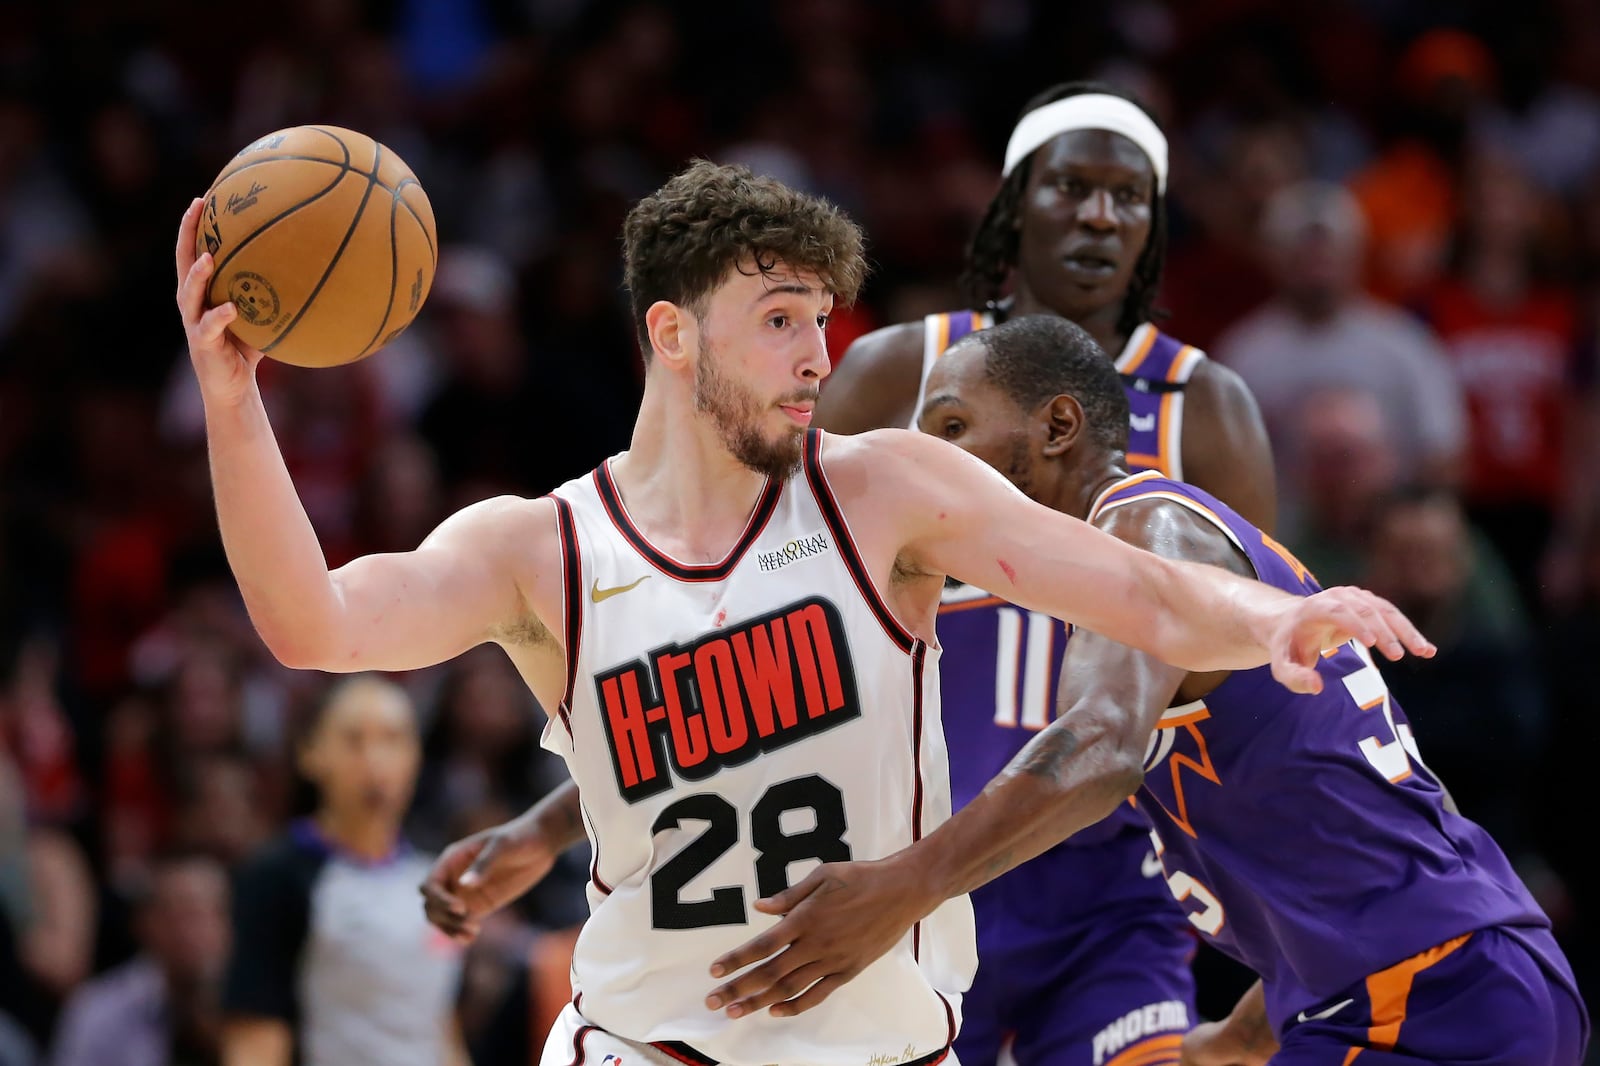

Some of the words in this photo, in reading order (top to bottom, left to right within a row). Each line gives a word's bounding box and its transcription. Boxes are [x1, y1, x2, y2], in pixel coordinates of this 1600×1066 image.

[757, 533, 826, 564] MEMORIAL
[758, 538, 828, 571] HERMANN
[993, 606, 1055, 730] 11
[650, 772, 854, 930] 28
